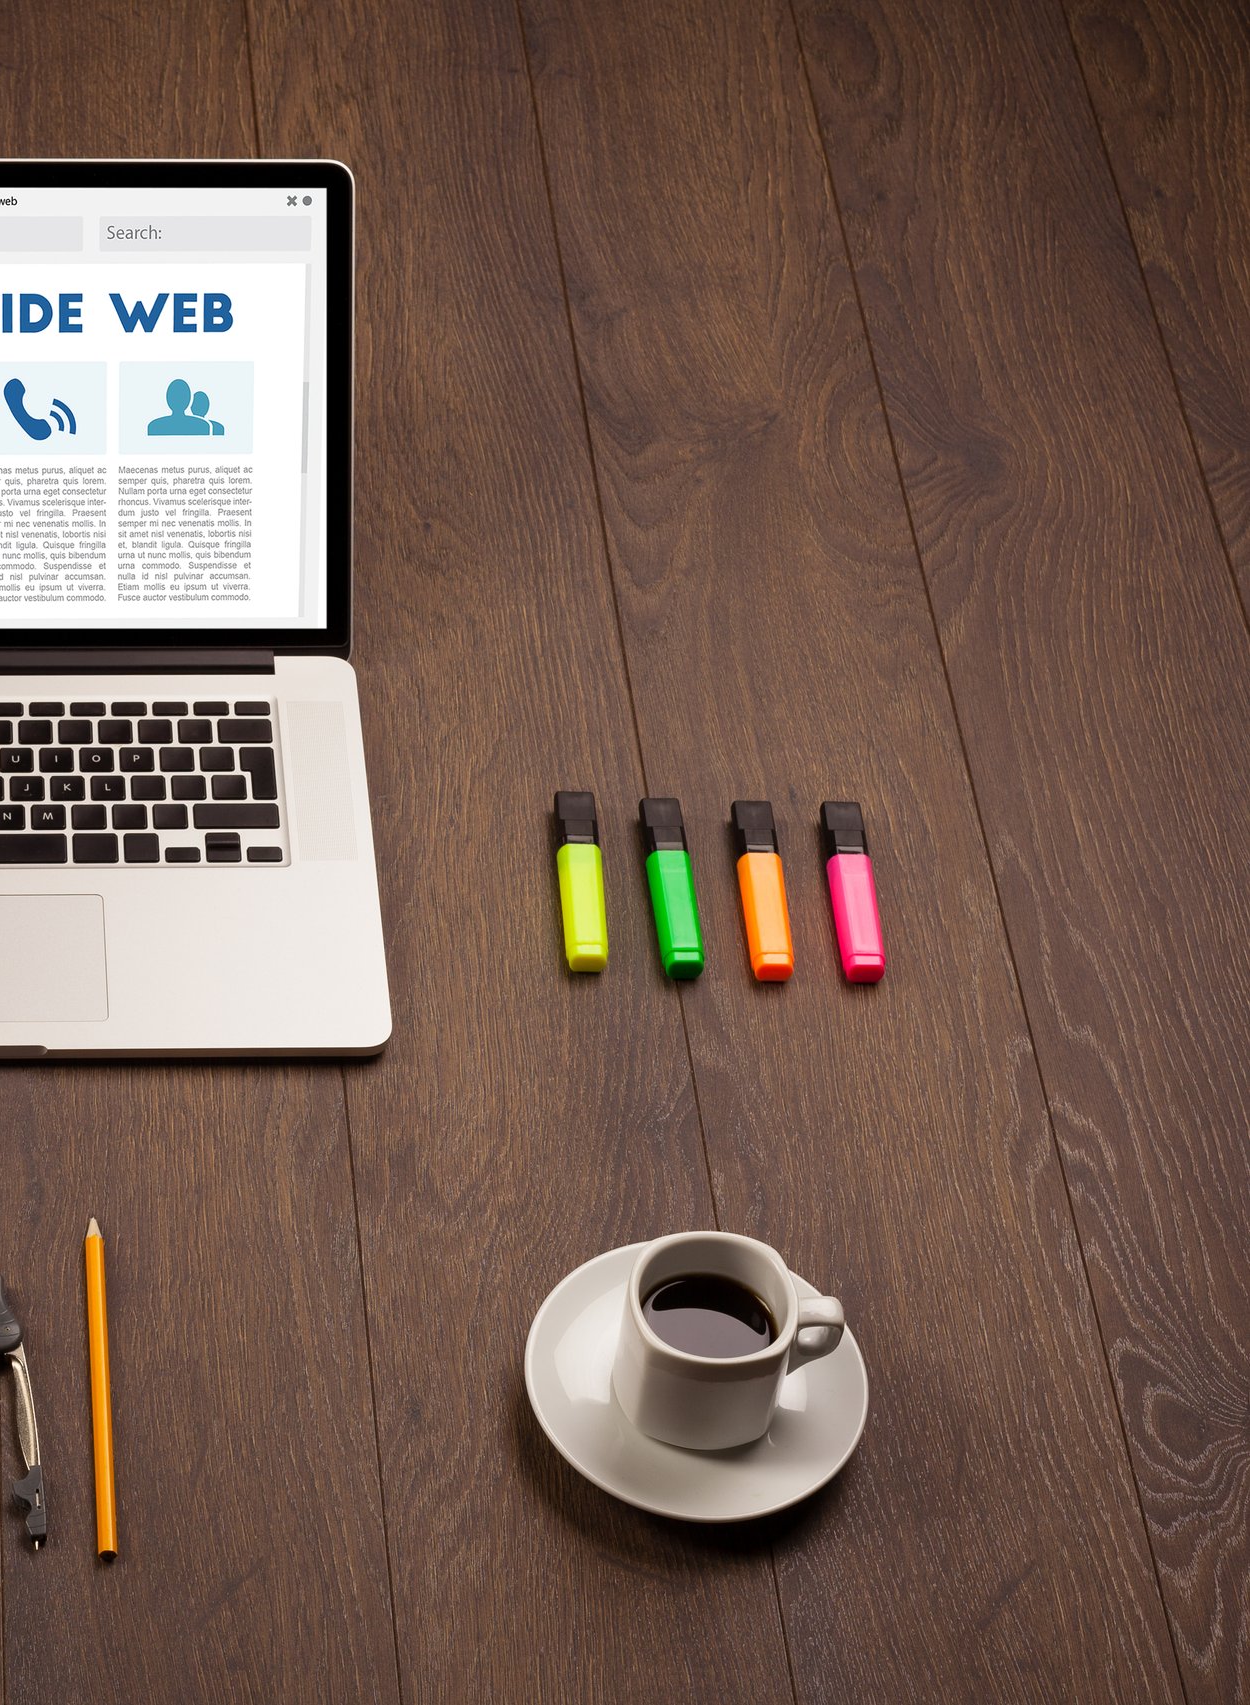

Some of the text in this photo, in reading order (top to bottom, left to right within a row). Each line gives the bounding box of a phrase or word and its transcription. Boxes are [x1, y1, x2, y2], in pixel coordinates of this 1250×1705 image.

[107, 225, 161, 239] Search:
[109, 293, 233, 332] WEB
[15, 466, 39, 474] metus
[42, 468, 65, 477] purus,
[69, 466, 94, 477] aliquet
[119, 466, 158, 474] Maecenas
[162, 466, 185, 474] metus
[188, 467, 211, 476] purus,
[215, 466, 240, 476] aliquet
[1, 488, 21, 498] porta
[43, 488, 60, 498] eget
[62, 488, 106, 496] consectetur
[118, 487, 145, 495] Nullam
[147, 487, 167, 497] porta
[189, 487, 206, 497] eget
[208, 487, 252, 495] consectetur
[7, 498, 40, 506] Vivamus
[42, 498, 85, 508] scelerisque
[87, 498, 106, 506] inter-
[118, 498, 252, 508] rhoncus. Vivamus scelerisque inter-
[43, 562, 92, 572] Suspendisse
[99, 562, 106, 570] et
[142, 562, 181, 570] commodo.
[188, 562, 237, 572] Suspendisse
[244, 562, 251, 570] et
[24, 594, 64, 602] vestibulum
[66, 594, 106, 602] commodo.
[118, 594, 251, 602] Fusce auctor vestibulum commodo.
